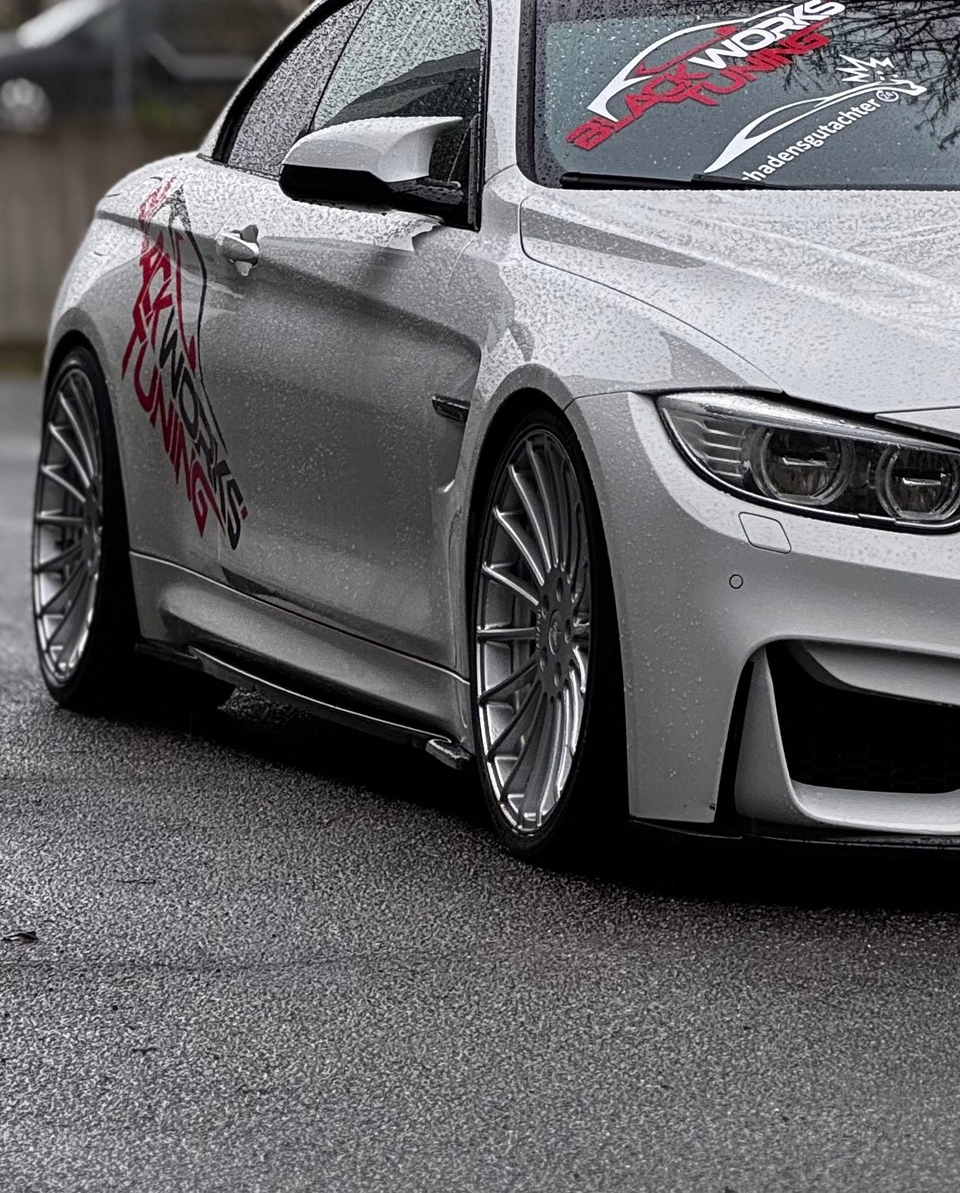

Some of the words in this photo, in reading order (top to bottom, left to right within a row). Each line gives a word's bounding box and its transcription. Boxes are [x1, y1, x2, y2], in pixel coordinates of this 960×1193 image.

[654, 17, 832, 106] TUNING
[565, 62, 713, 151] BLACK
[741, 98, 882, 182] hadensgutachter
[158, 305, 242, 550] WORKS
